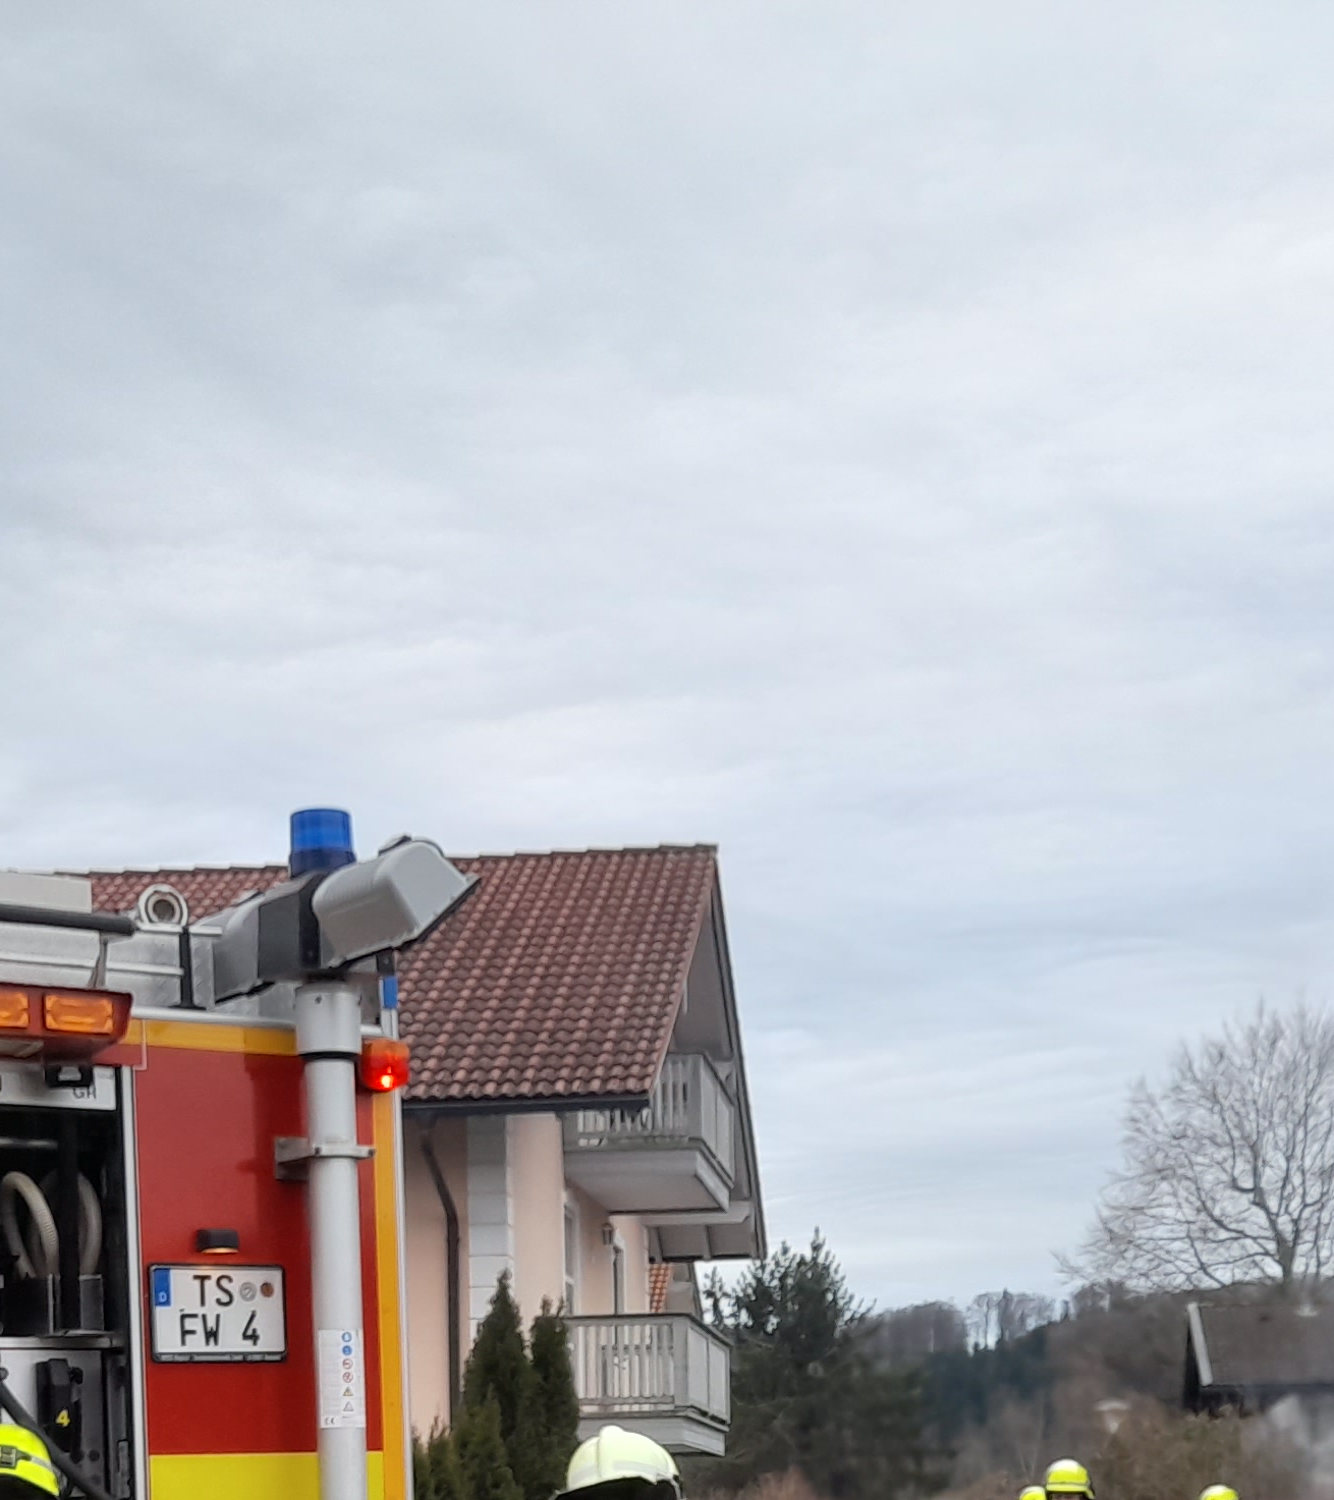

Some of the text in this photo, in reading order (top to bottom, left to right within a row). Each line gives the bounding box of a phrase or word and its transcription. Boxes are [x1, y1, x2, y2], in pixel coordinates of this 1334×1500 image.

[193, 1274, 235, 1307] TS
[179, 1310, 261, 1347] FW 4
[56, 1409, 70, 1427] 4
